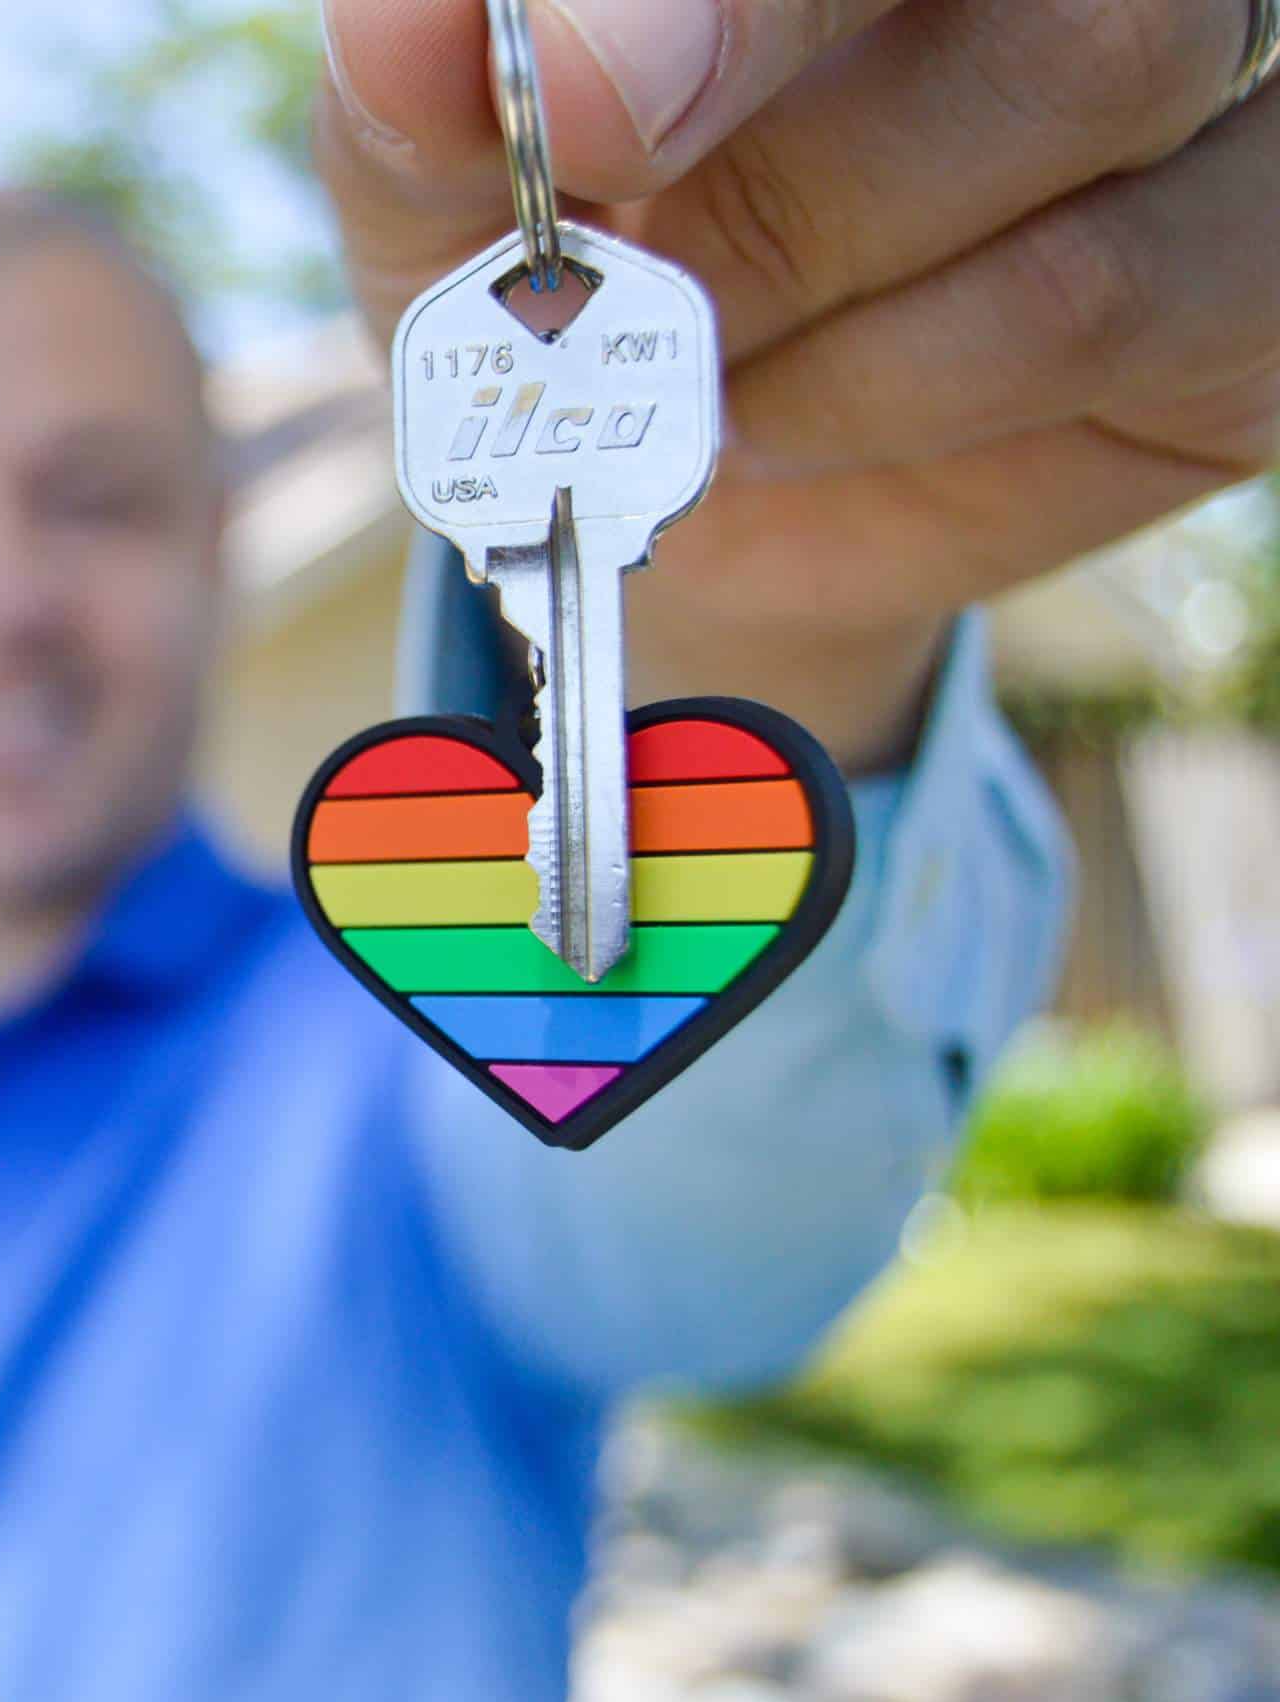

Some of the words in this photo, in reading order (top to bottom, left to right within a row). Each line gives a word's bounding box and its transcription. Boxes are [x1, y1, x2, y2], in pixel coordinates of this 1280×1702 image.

[420, 342, 515, 381] 1176
[601, 329, 679, 365] KW1
[447, 382, 657, 462] ilco
[431, 476, 498, 504] USA
